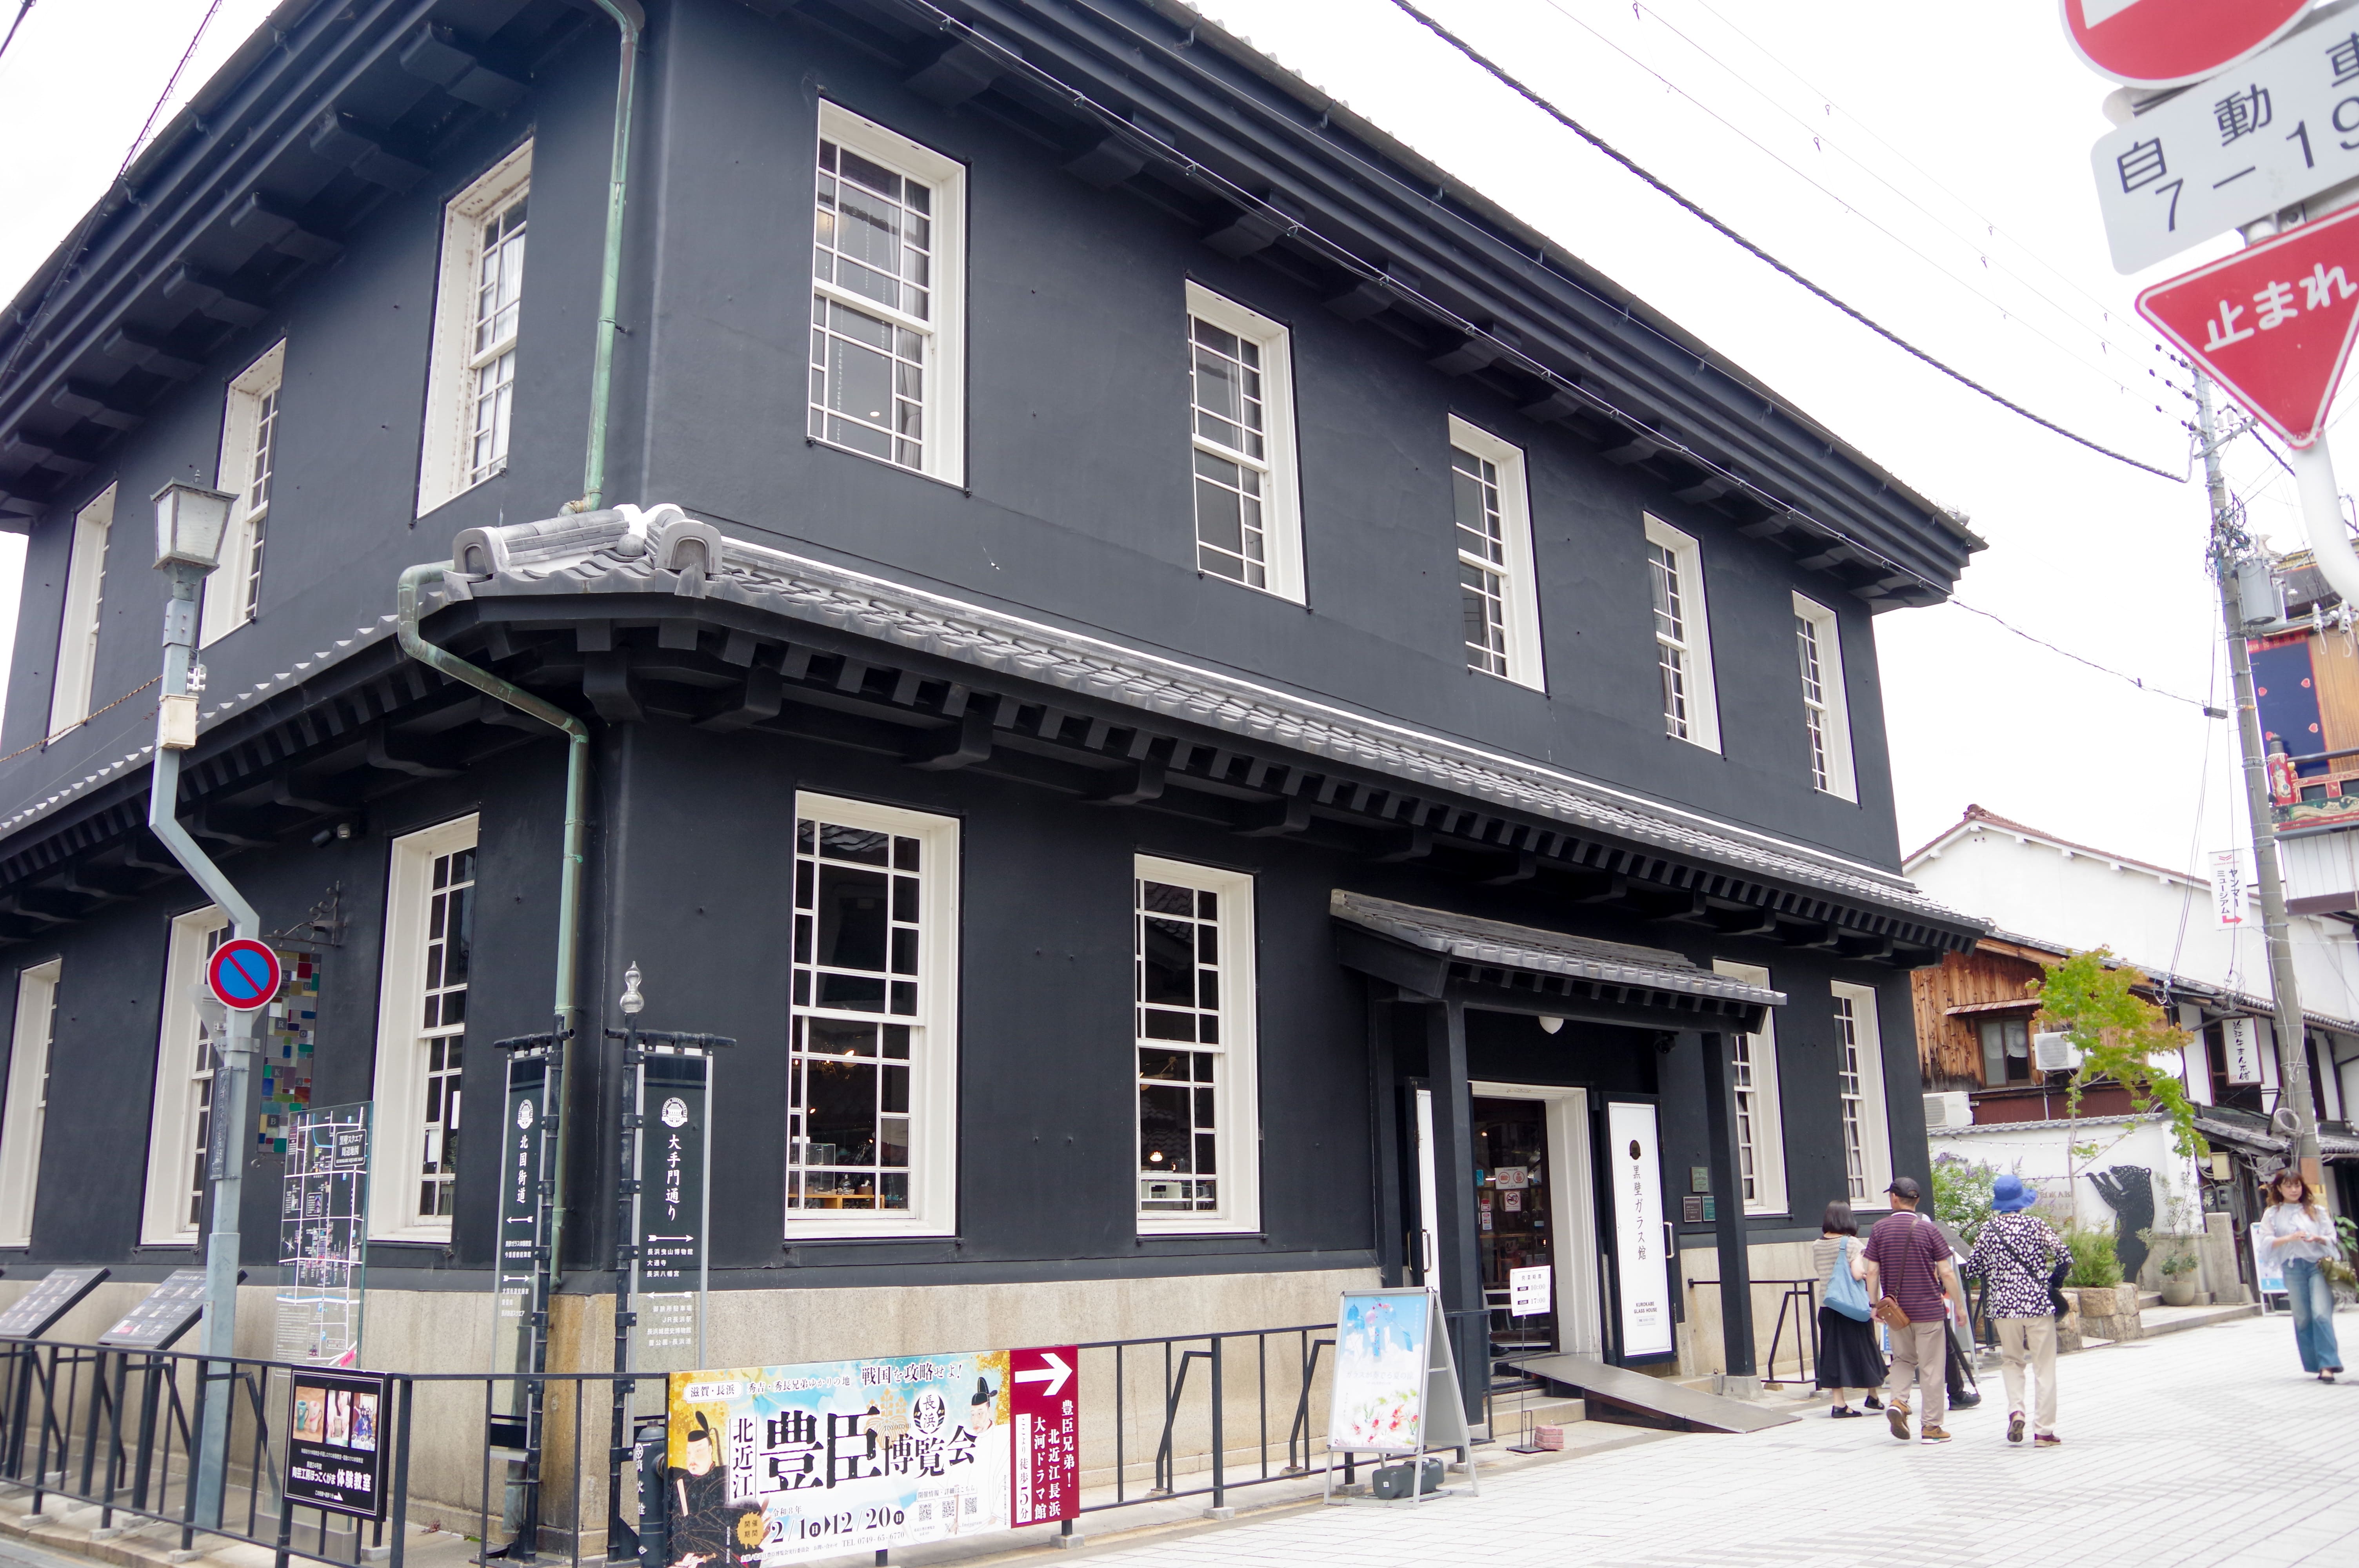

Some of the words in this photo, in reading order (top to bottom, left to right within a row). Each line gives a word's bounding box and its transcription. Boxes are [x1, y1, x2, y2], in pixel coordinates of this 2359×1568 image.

[2204, 262, 2357, 352] 止まれ
[2217, 871, 2230, 913] ミュージアム
[2229, 869, 2240, 907] ヤンマー
[339, 1134, 363, 1145] 黒壁スクエア
[341, 1145, 359, 1156] 周辺地図
[516, 1134, 529, 1204] 北国街道
[665, 1134, 682, 1221] 大手門通り
[1633, 1165, 1646, 1260] 黒壁ガラス館
[691, 1384, 734, 1398] 滋賀・長浜
[747, 1376, 851, 1394] 秀吉・秀長兄弟ゆかりの地
[922, 1394, 936, 1428] 長浜
[292, 1466, 336, 1485] 陶芸工房ほっこくがま
[337, 1468, 371, 1492] 体験教室
[732, 1418, 754, 1499] 北近江
[1034, 1416, 1047, 1520] 大河ドラマ館
[1048, 1428, 1061, 1517] 北近江長浜
[636, 1459, 646, 1515] 消火栓
[772, 1505, 802, 1517] 令和8年
[813, 1542, 838, 1550] お問い合わせ
